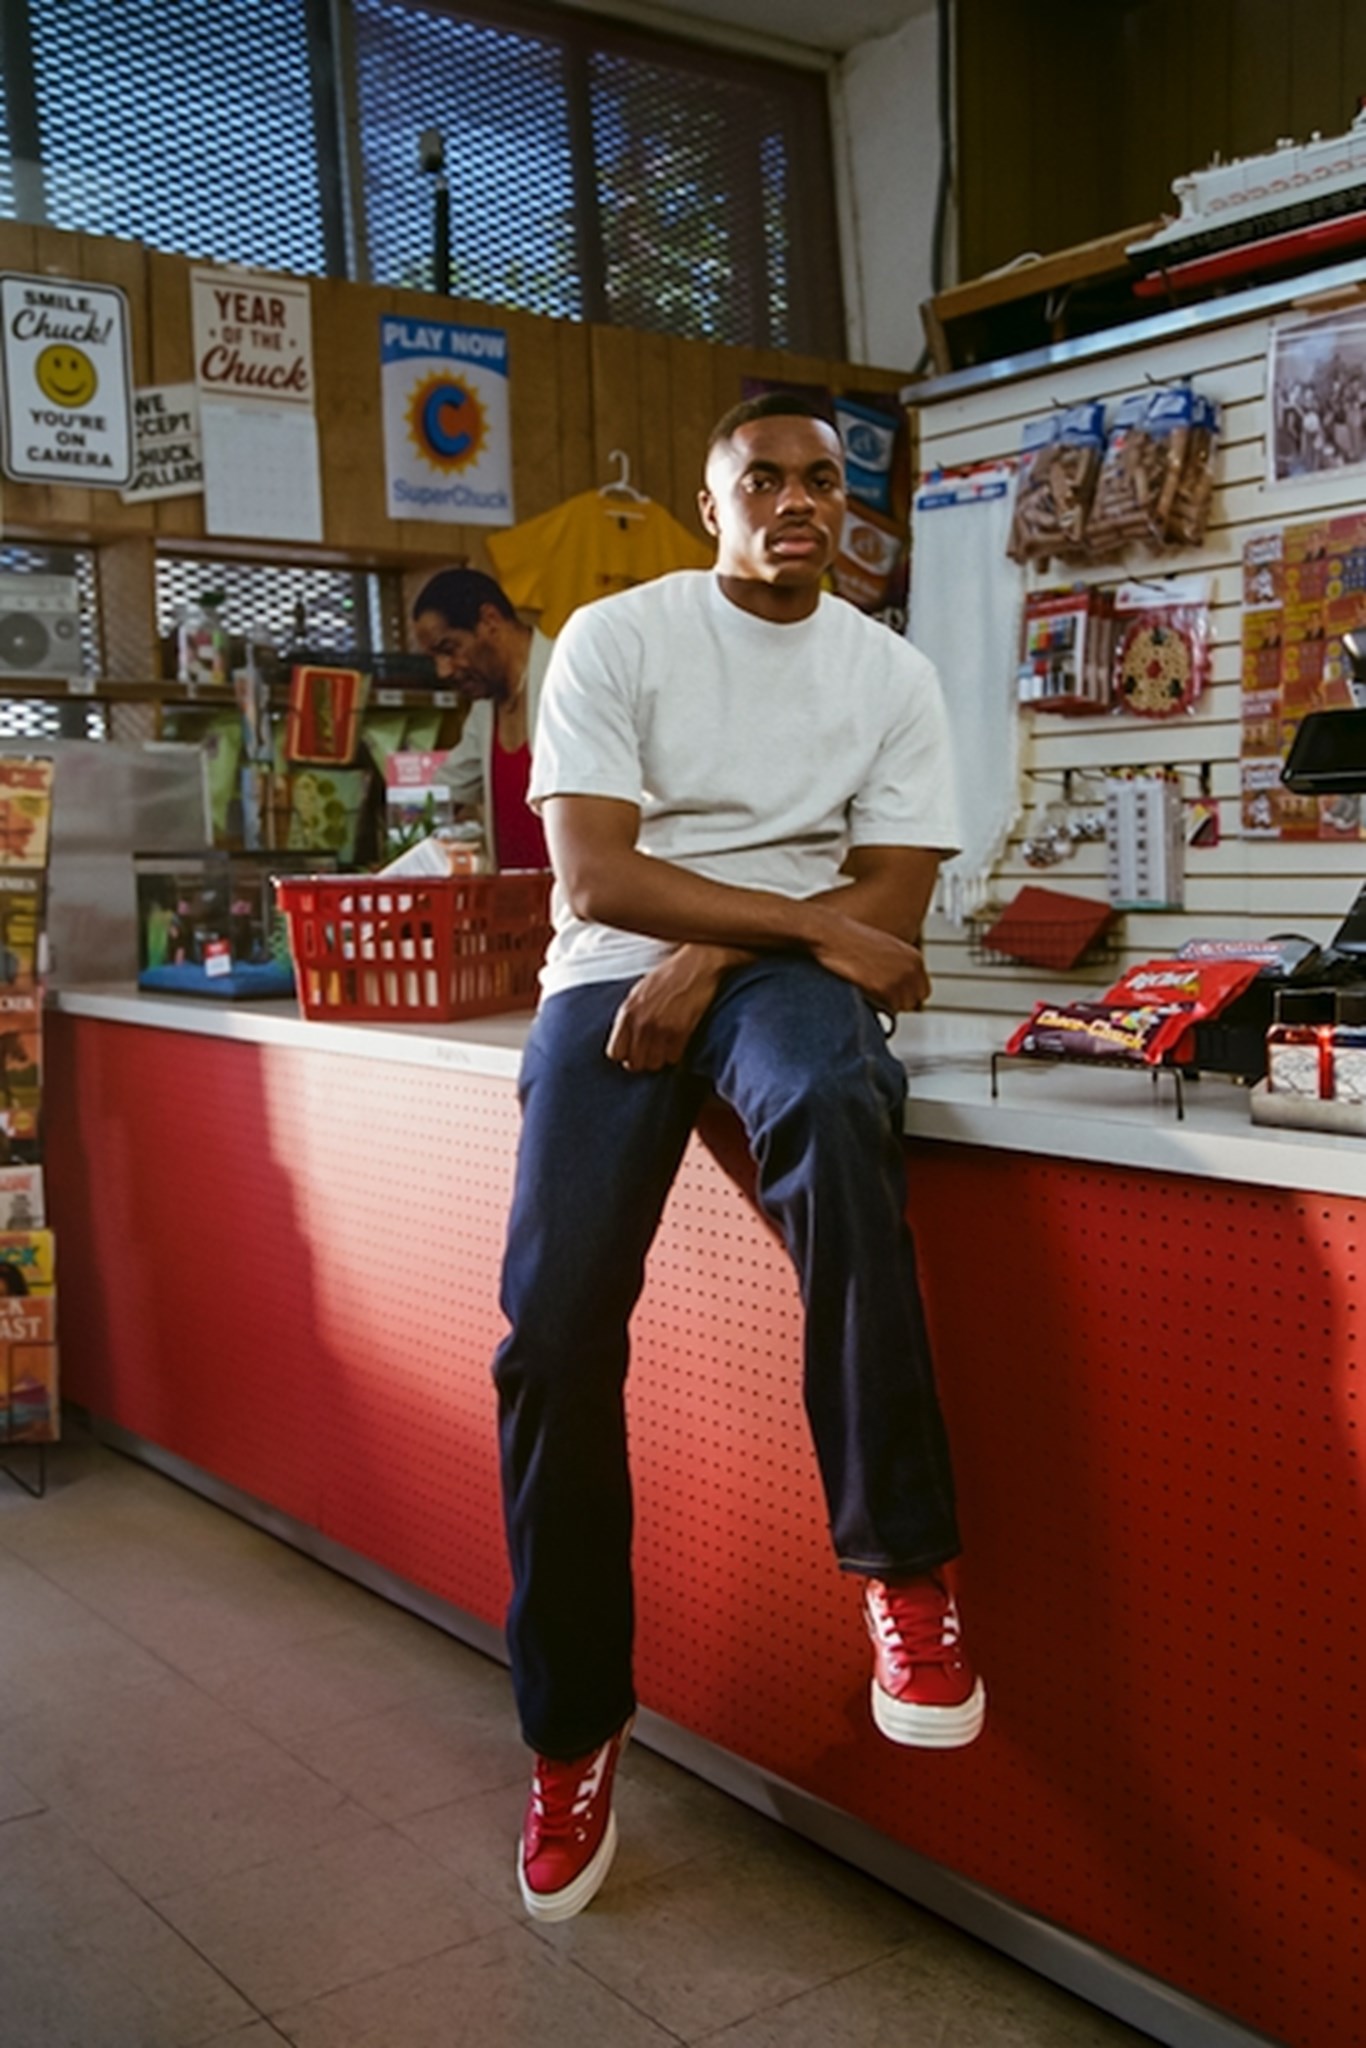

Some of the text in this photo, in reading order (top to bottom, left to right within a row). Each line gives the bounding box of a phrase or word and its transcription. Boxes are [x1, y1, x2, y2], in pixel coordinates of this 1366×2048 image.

[24, 289, 98, 314] SMILE,
[213, 289, 286, 329] YEAR
[11, 308, 114, 345] Chuck!
[221, 326, 283, 351] OF THE
[385, 321, 505, 359] PLAY NOW
[201, 344, 310, 393] Chuck
[29, 408, 107, 432] YOU'RE
[423, 384, 471, 458] C
[55, 430, 87, 447] ON
[26, 446, 113, 469] CAMERA
[392, 477, 509, 510] SuperChuck
